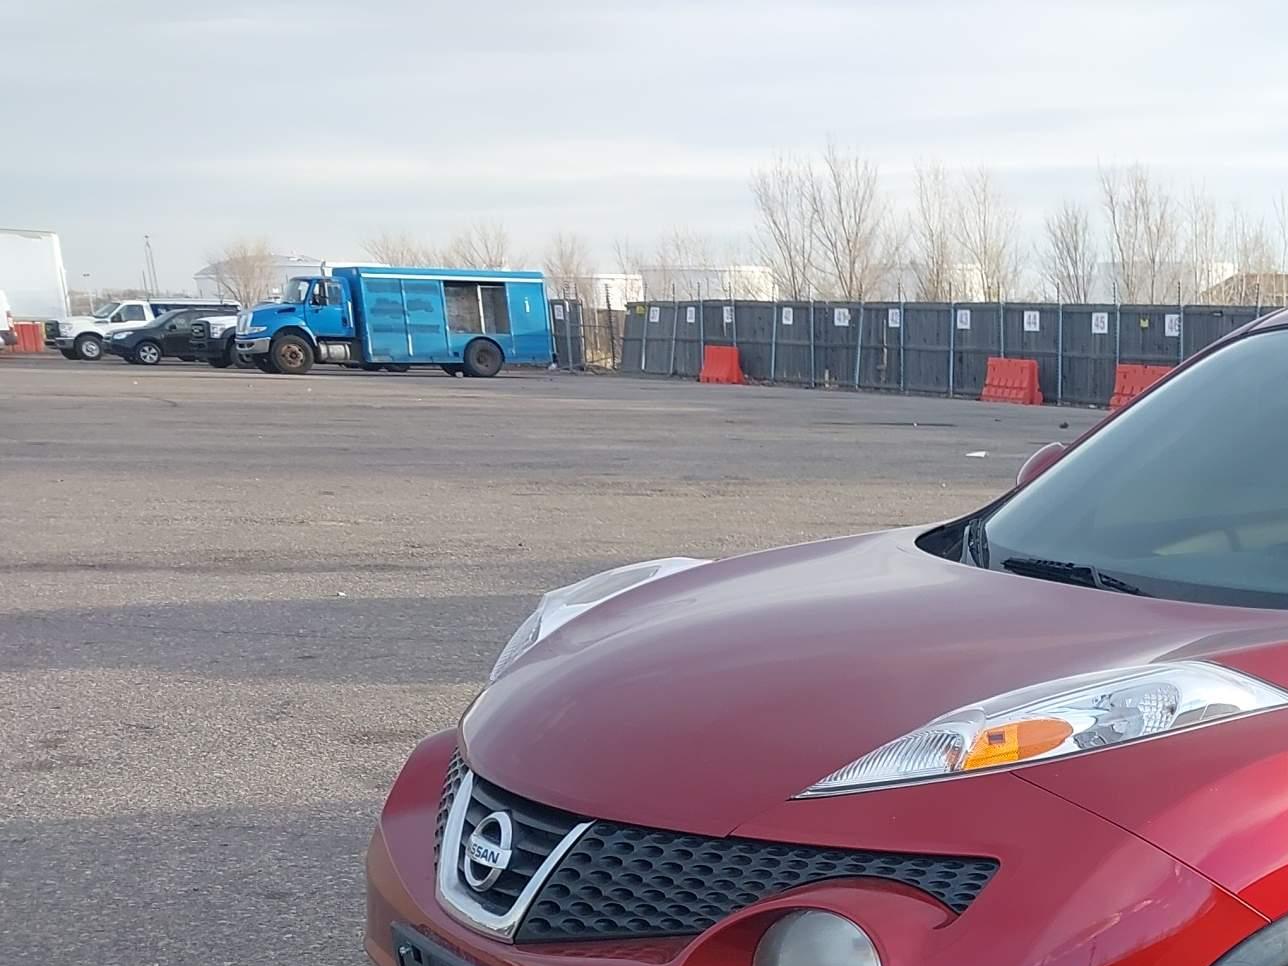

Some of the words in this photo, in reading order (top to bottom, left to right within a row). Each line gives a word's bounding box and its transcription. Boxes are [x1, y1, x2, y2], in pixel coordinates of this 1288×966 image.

[1026, 314, 1038, 328] 44
[1094, 315, 1105, 330] 45
[468, 841, 501, 864] SSAN
